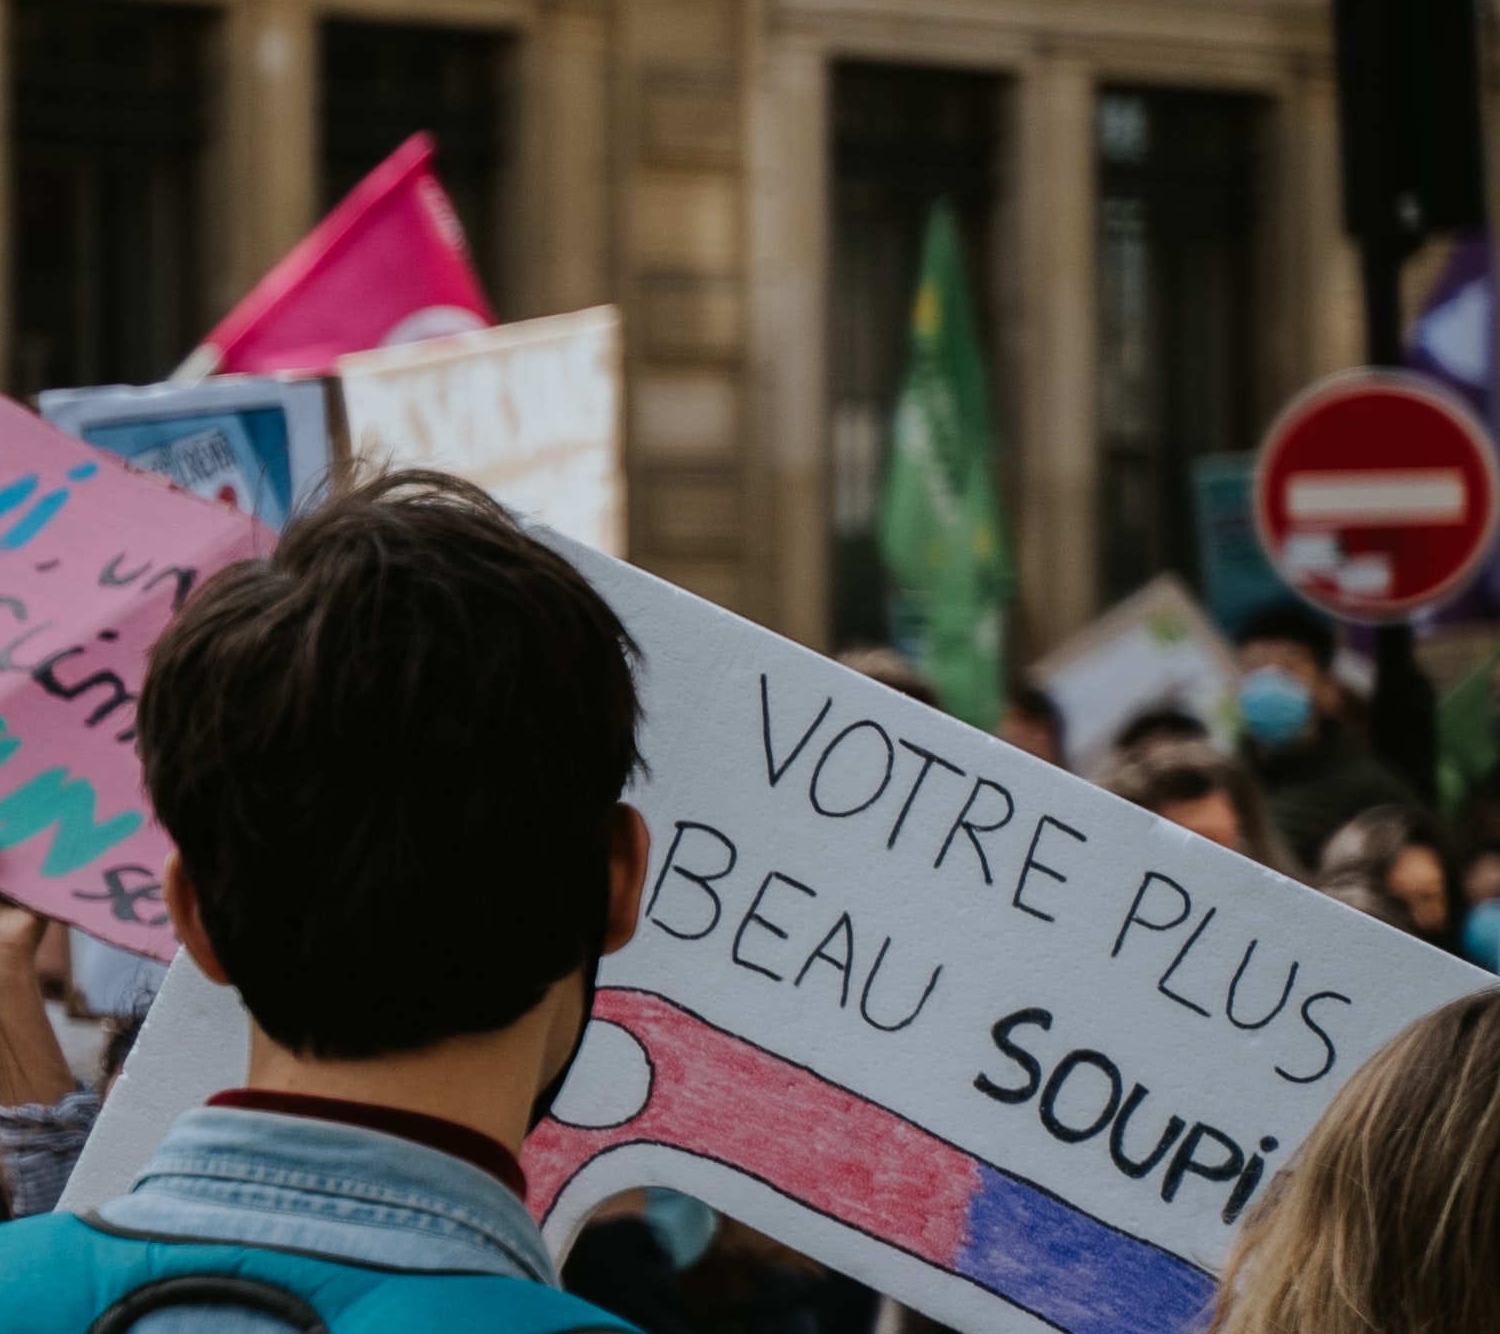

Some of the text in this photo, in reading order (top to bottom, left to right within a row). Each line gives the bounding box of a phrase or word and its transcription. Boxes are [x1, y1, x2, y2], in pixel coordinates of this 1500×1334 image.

[98, 551, 198, 617] un
[72, 862, 174, 929] se
[645, 819, 944, 1033] BEAU
[759, 672, 1354, 1085] VOTRE PLUS
